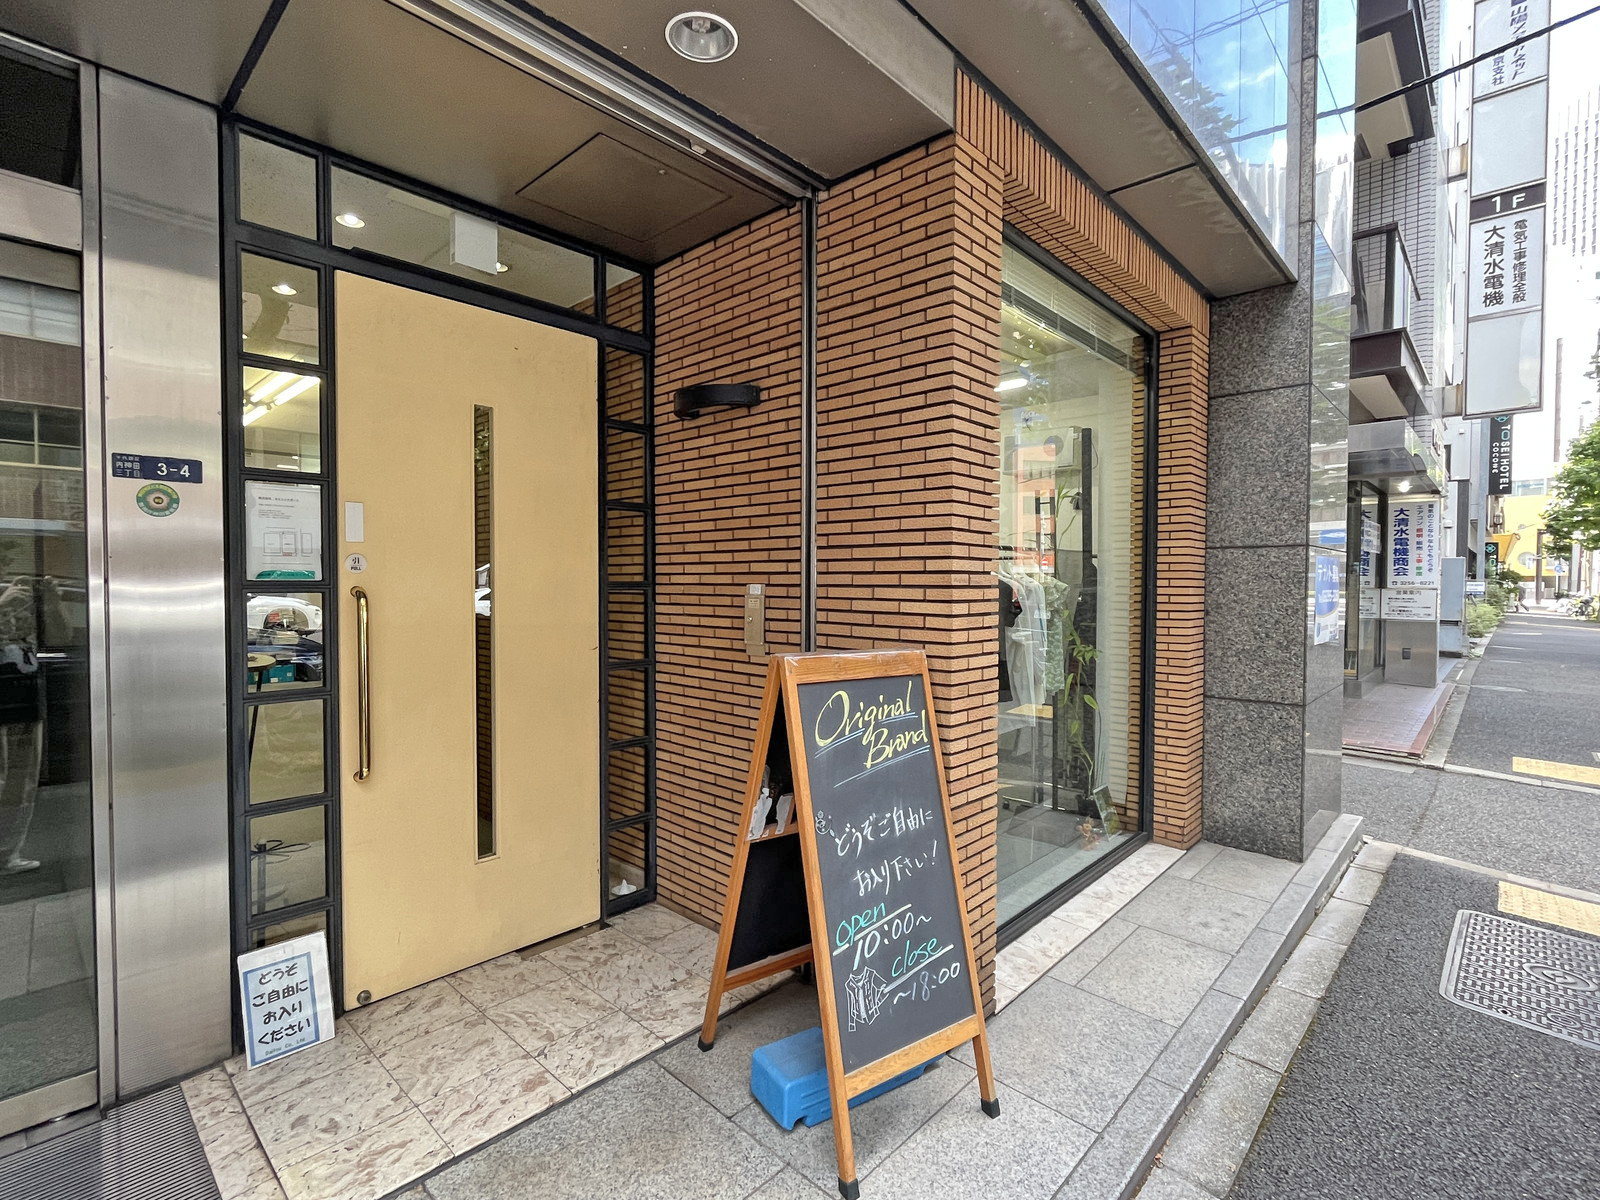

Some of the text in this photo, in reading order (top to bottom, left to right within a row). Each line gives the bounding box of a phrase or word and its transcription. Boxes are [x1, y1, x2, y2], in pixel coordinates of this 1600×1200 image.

[1492, 193, 1526, 213] 1F
[1483, 225, 1505, 308] 大清水電機
[1512, 219, 1528, 304] 電気工事修理全般
[157, 463, 191, 478] 3-4
[1499, 424, 1511, 490] TOSEI HOTEL
[352, 556, 360, 565] 引
[1392, 507, 1410, 577] 大清水電機商会
[815, 680, 912, 746] Original
[863, 709, 929, 769] Brand
[834, 806, 934, 859] どうぞご自由に
[836, 902, 886, 947] open
[891, 938, 943, 977] close
[252, 979, 309, 1008] ご自由に
[263, 1000, 303, 1025] お入り
[258, 1018, 311, 1045] ください
